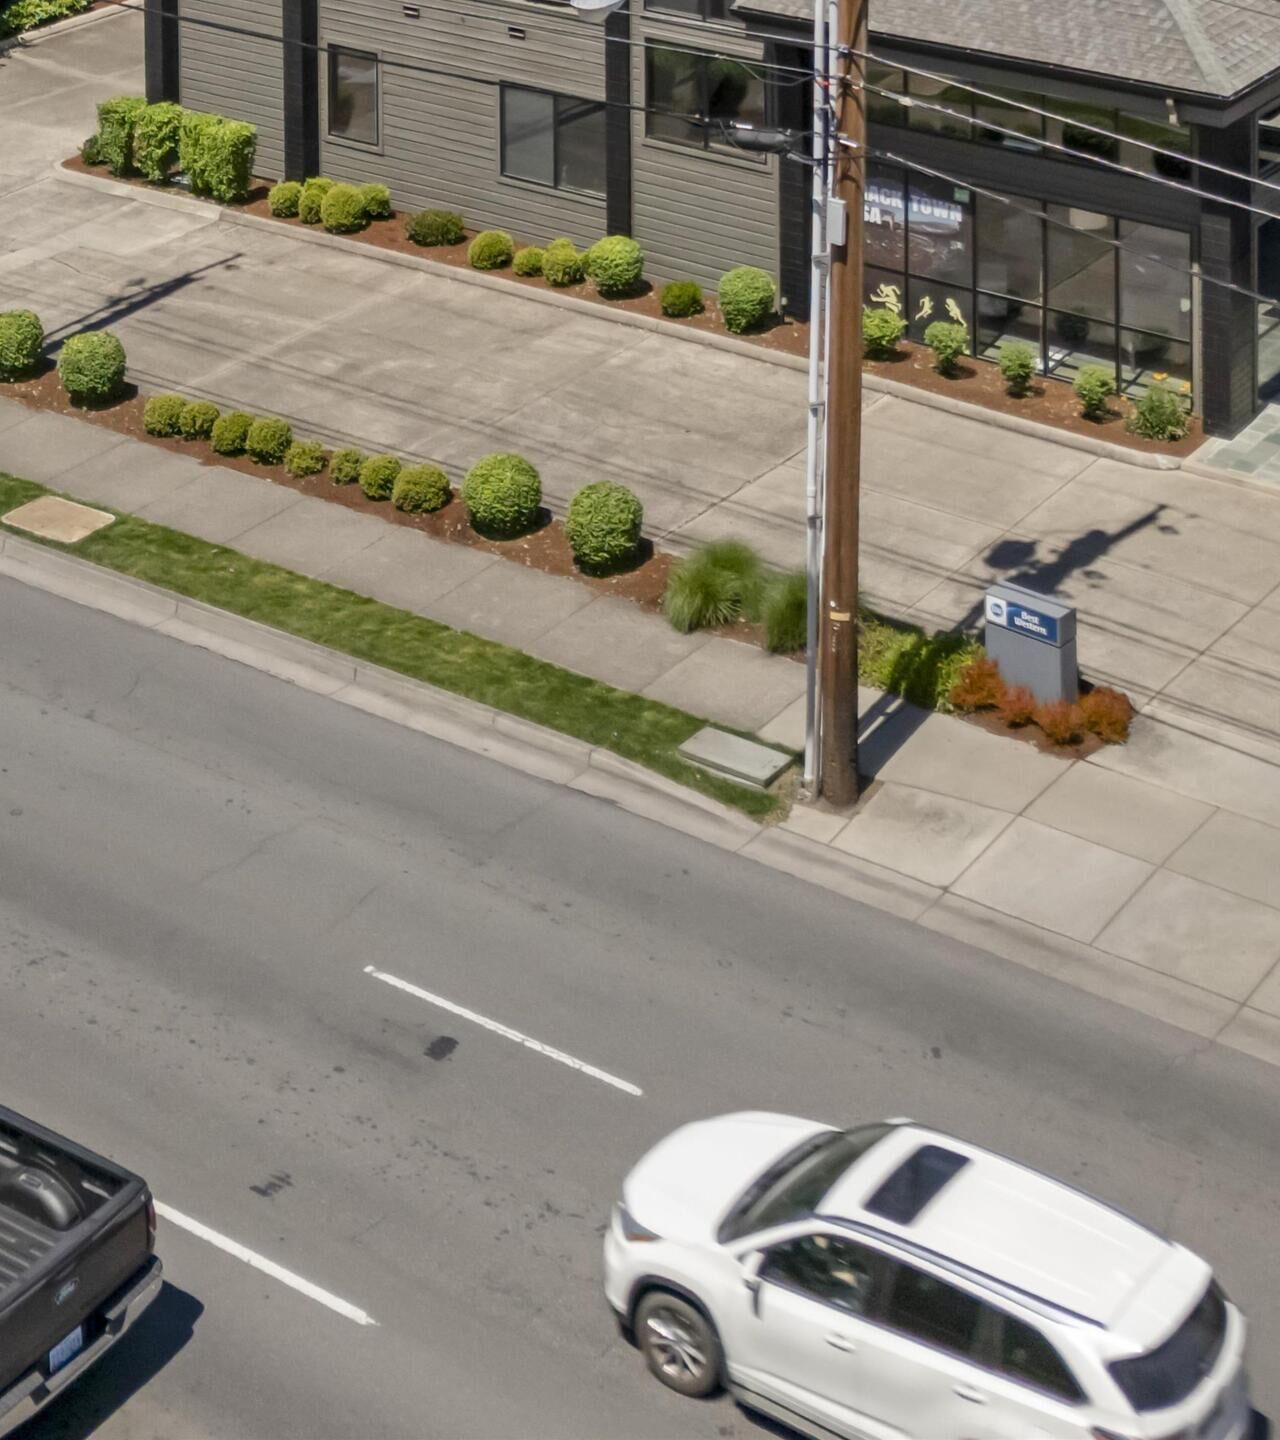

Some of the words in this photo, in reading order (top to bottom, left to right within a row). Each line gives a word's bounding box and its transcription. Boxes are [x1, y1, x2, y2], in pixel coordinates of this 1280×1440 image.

[910, 193, 963, 222] TOWN
[1013, 616, 1048, 636] Western
[1021, 610, 1039, 625] Best
